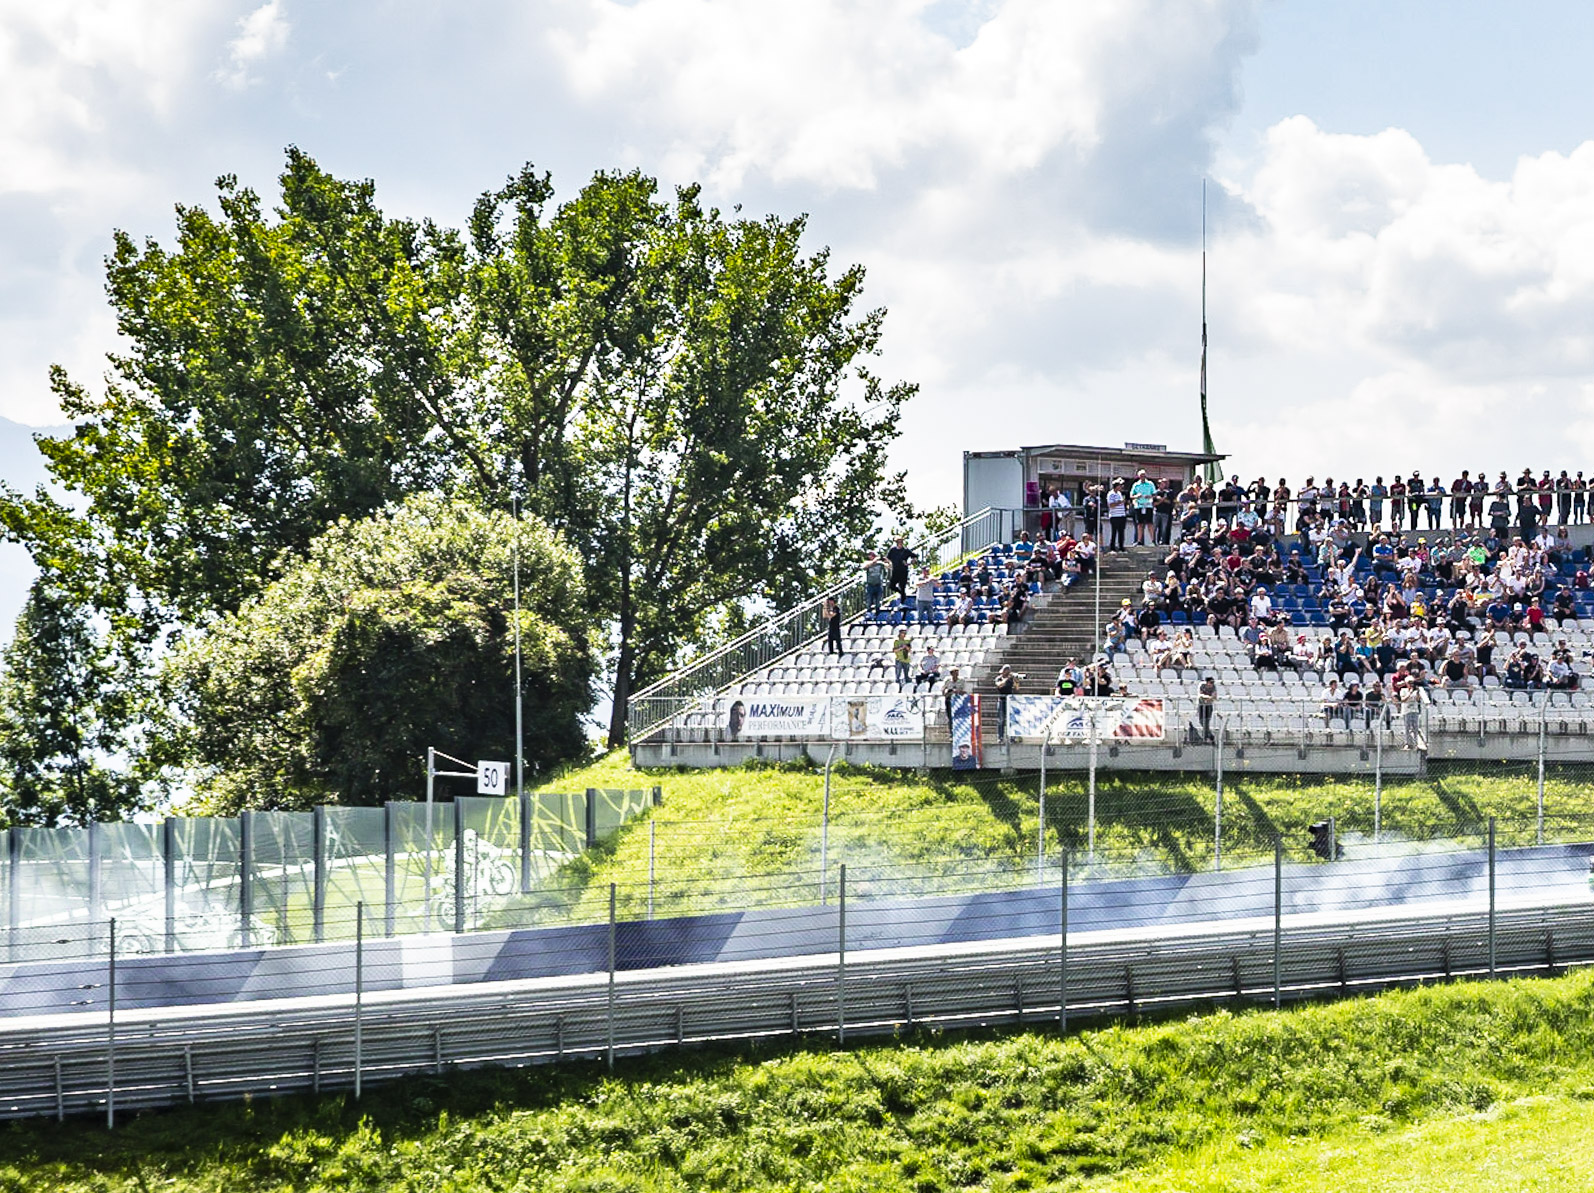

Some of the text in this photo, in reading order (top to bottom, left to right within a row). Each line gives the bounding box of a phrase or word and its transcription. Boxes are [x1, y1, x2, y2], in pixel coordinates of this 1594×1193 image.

[749, 704, 805, 718] MAXIMUM
[748, 720, 807, 731] PERFORMANCE
[483, 767, 498, 788] 50
